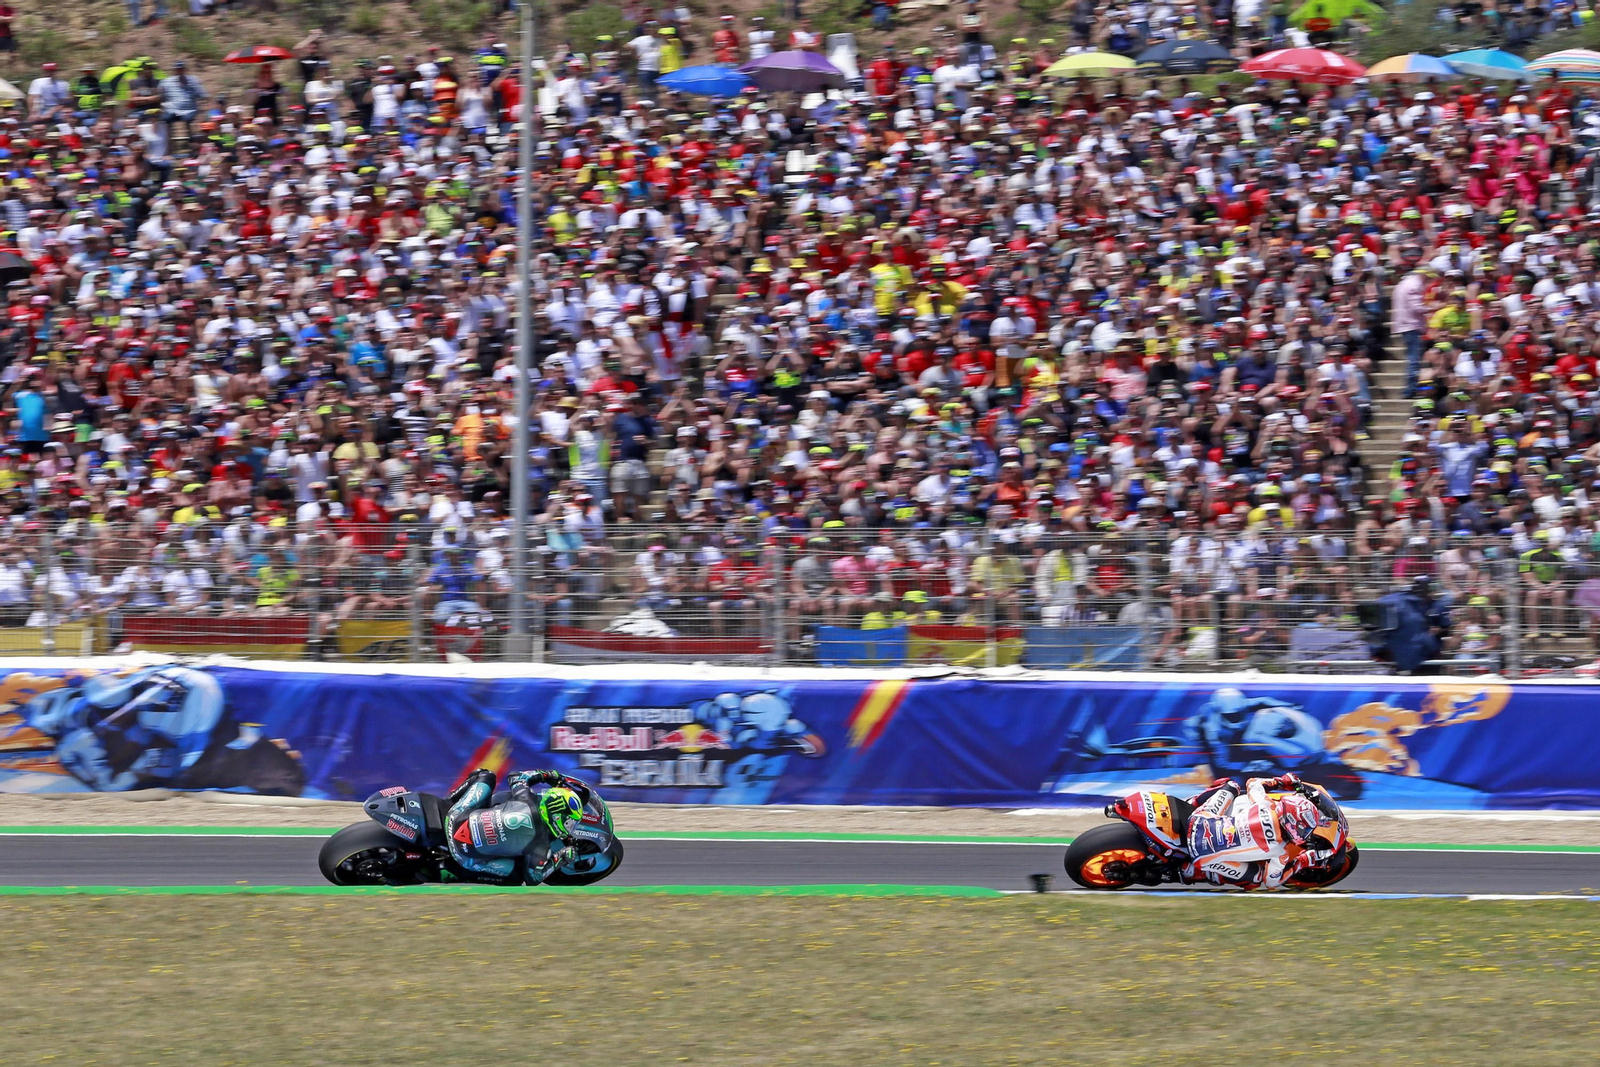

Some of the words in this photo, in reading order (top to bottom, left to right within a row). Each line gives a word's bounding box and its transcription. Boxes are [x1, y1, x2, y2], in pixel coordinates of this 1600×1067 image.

[551, 726, 601, 750] Red
[600, 726, 653, 751] Bull
[1143, 793, 1154, 824] REPSOL
[1211, 790, 1227, 815] REPSO
[390, 813, 419, 830] PETRONAS
